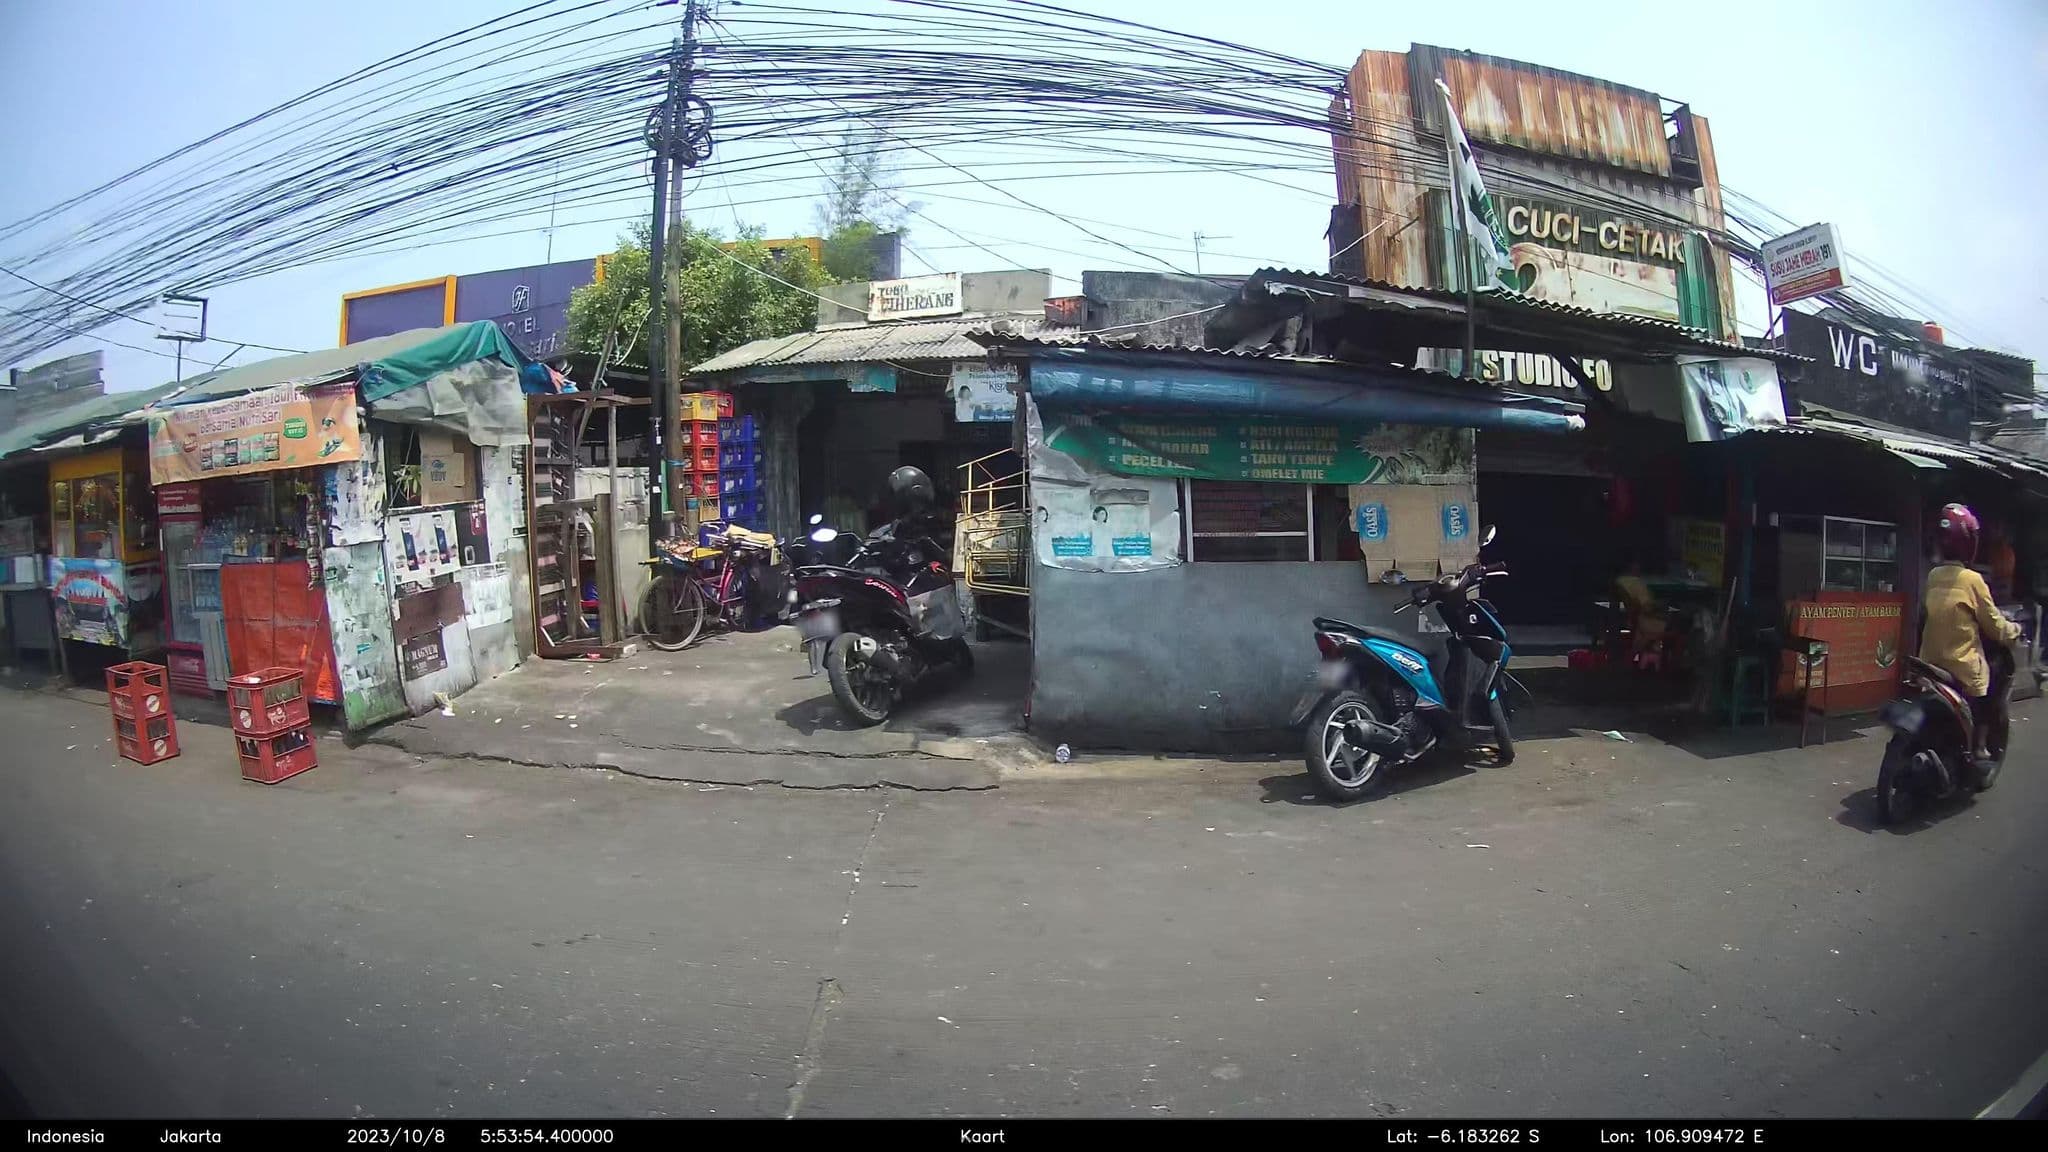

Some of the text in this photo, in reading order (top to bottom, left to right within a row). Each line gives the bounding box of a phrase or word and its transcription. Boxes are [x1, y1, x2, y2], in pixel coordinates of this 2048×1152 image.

[1507, 206, 1685, 263] CUCI-CETAK
[1828, 326, 1877, 376] WC
[1122, 454, 1165, 468] PECEL
[1301, 469, 1324, 480] MIE
[1363, 507, 1378, 537] OASIS
[1450, 505, 1462, 536] OASIS
[1801, 607, 1826, 618] AYAM
